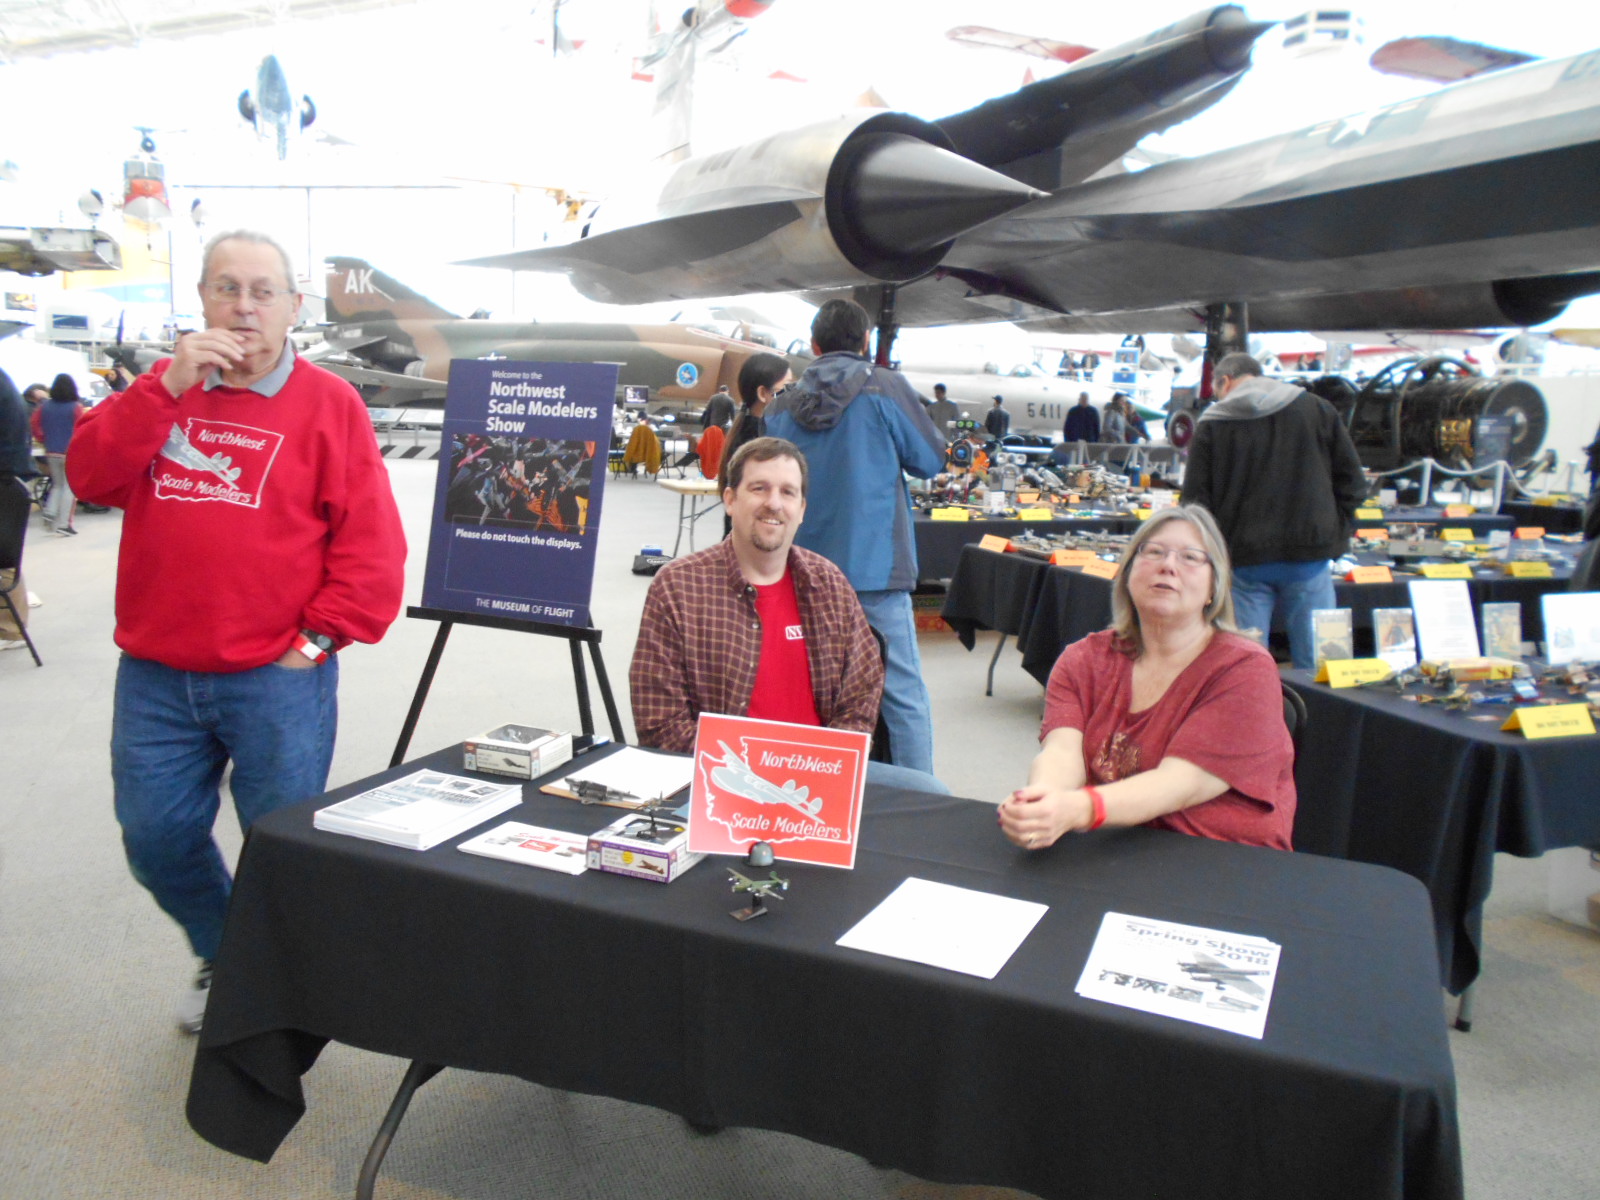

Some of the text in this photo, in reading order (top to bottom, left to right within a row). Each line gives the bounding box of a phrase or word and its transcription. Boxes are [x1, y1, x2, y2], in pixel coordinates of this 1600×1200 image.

[344, 269, 374, 293] AK
[492, 370, 521, 379] Welcome
[490, 381, 566, 399] Northwest
[488, 399, 598, 419] Scale Modelers
[1027, 402, 1061, 419] 5411
[486, 416, 526, 433] Show
[160, 473, 253, 503] Scale Modelers
[455, 528, 582, 550] Please do not touch the displays.
[476, 598, 575, 618] THE MUSEUM OF FLIGHT
[759, 751, 843, 775] NorthWest
[730, 812, 842, 840] Scale Modelers
[1125, 924, 1271, 959] Spring Show
[1213, 950, 1270, 966] 2018
